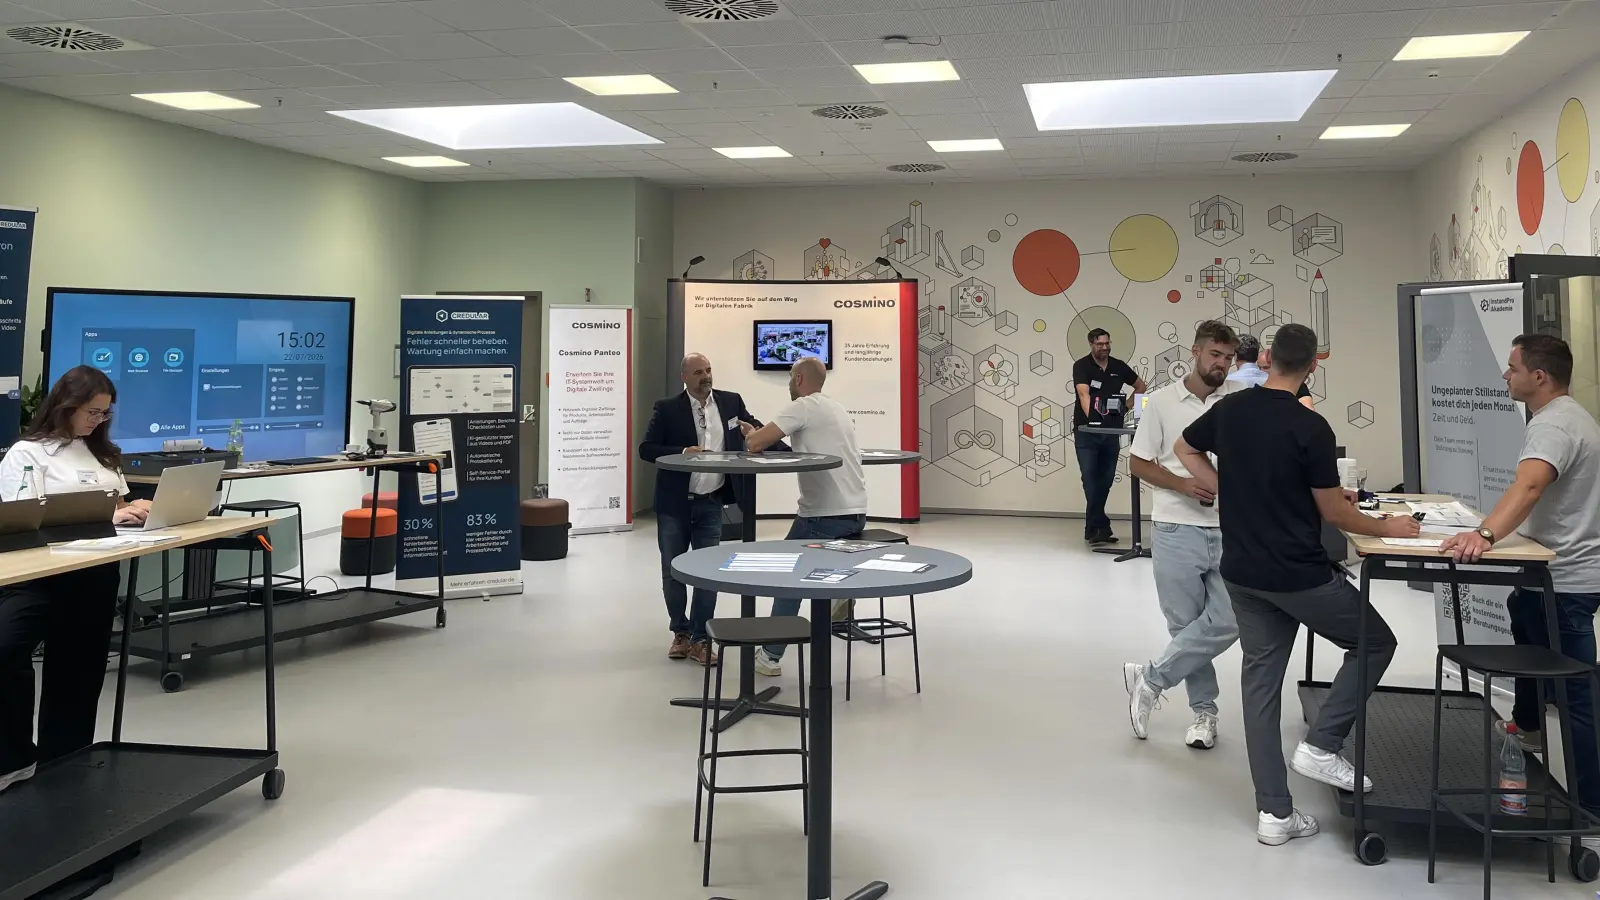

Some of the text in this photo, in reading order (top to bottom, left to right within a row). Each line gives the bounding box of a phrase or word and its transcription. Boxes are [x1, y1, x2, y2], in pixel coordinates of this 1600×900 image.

[0, 221, 26, 229] REDULAR
[451, 312, 489, 320] CREDULAR
[278, 332, 325, 348] 15:02
[284, 353, 324, 361] 22/07/2026
[407, 348, 442, 356] Wartung
[1431, 385, 1509, 398] Ungeplanter Stillstand
[1432, 398, 1515, 412] kostet dich jeden Monat
[1433, 413, 1475, 425] Zeit und Geld.
[404, 518, 433, 530] 30 %
[467, 513, 497, 526] 83 %
[1471, 595, 1485, 604] Buch
[1494, 602, 1504, 610] ein
[1472, 607, 1505, 622] kostenloses
